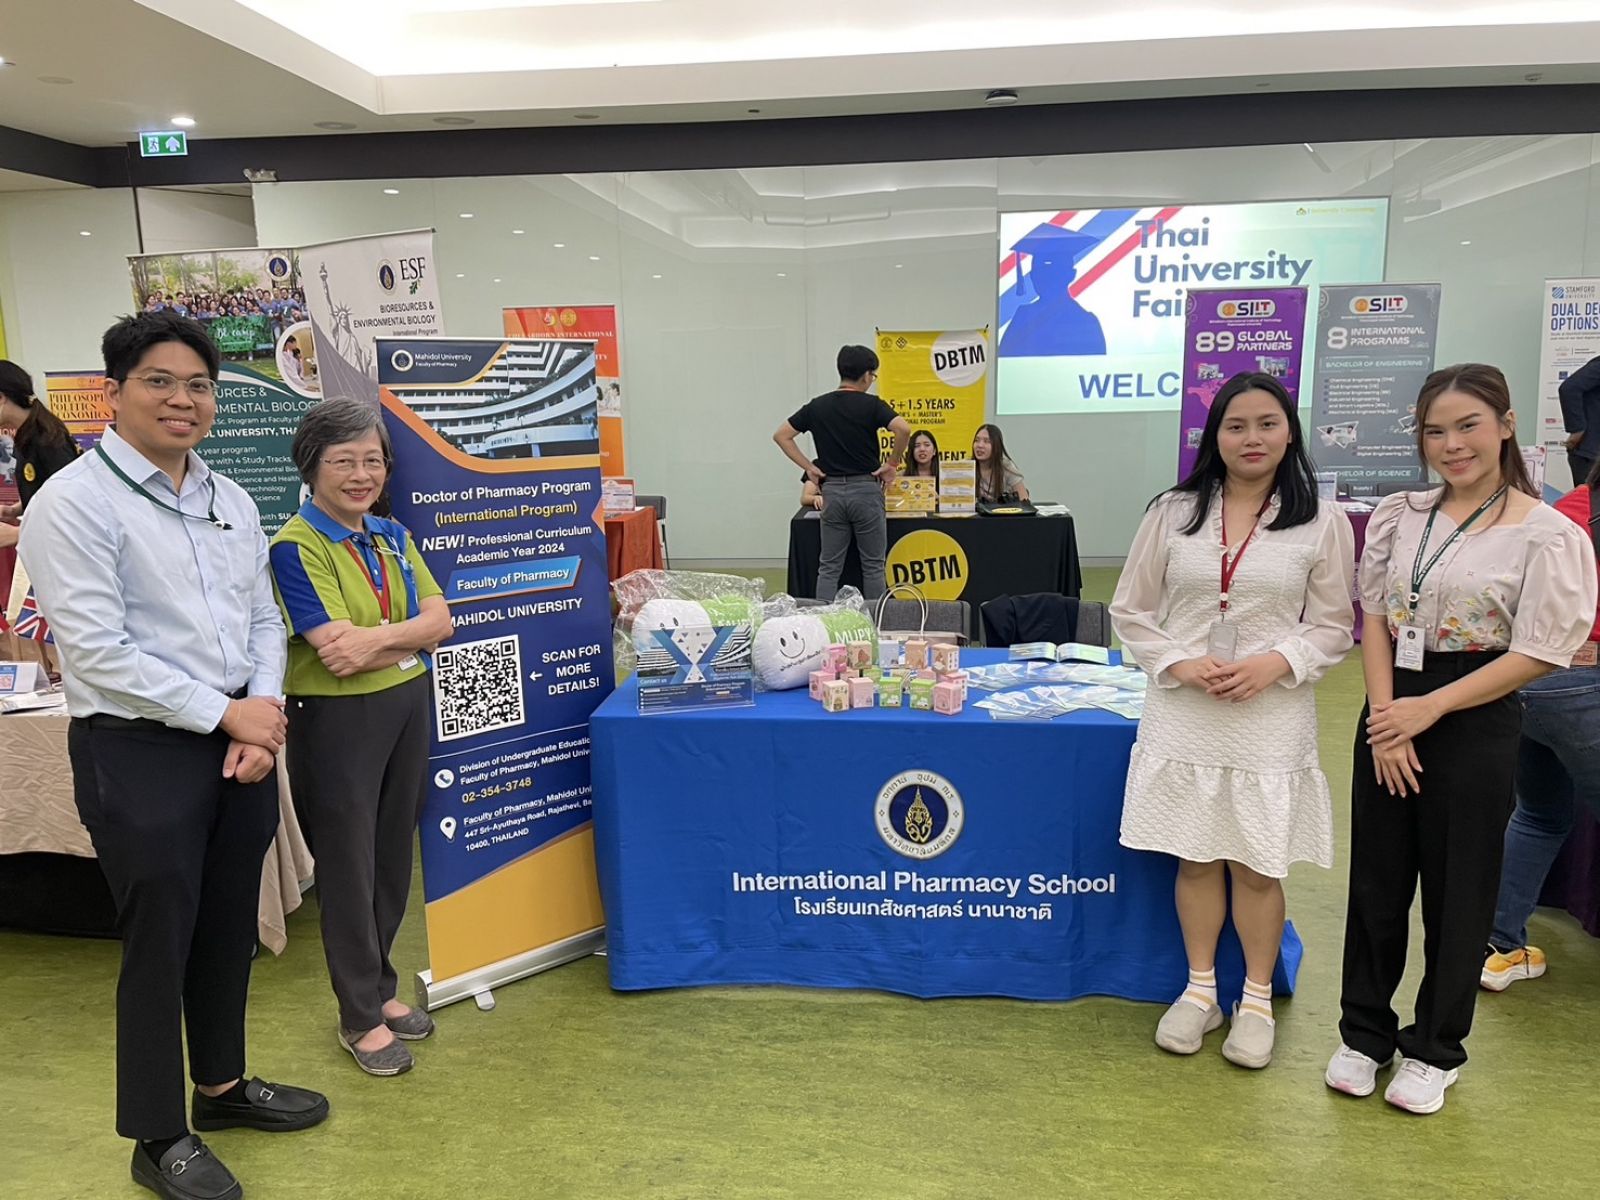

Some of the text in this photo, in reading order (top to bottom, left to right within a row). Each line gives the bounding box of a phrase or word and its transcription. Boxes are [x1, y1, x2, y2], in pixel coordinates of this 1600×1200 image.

[1135, 217, 1210, 249] Thai
[399, 257, 426, 280] ESF
[1134, 249, 1313, 286] University
[380, 301, 434, 313] BIORESOURCES &
[1132, 290, 1182, 318] Fai
[1236, 301, 1270, 316] SIIT
[1369, 297, 1404, 312] SIIT
[1551, 302, 1600, 317] DUAL DE
[353, 315, 436, 328] ENVIRONMENTAL BIOLOGY
[1550, 317, 1599, 331] OPTIONS
[1195, 330, 1293, 352] 89 GLOBAL
[1237, 342, 1293, 352] PARTNERS
[1327, 326, 1425, 349] 8 INTERNATIONAL
[1350, 336, 1410, 346] PROGRAMS
[441, 353, 472, 362] University
[934, 344, 985, 371] DBTM
[1326, 361, 1362, 369] BACHELOR
[1376, 360, 1423, 368] ENGINEERING
[216, 387, 267, 398] URCES &
[1079, 371, 1180, 399] WELC
[215, 401, 319, 414] MENTAL BIOLOG
[908, 399, 922, 410] 1.5
[925, 399, 955, 410] YEARS
[57, 411, 110, 420] CONOMICS
[228, 417, 259, 425] Program
[268, 416, 292, 424] Faculty
[217, 427, 279, 438] UNIVERSITY,
[881, 436, 895, 449] DE
[203, 448, 220, 456] year
[222, 446, 257, 456] program
[242, 456, 266, 465] Study
[267, 455, 291, 463] Tracks
[234, 466, 284, 474] Environmental
[412, 480, 592, 505] Doctor of Pharmacy Program
[435, 500, 577, 527] (International Program)
[422, 525, 592, 552] NEW! Professional Curriculum
[456, 542, 565, 565] Academic Year 2024
[456, 567, 570, 592] Faculty of Pharmacy
[892, 555, 961, 587] DBTM
[507, 597, 583, 619] UNIVERSITY
[542, 644, 601, 664] SCAN FOR
[556, 662, 591, 678] MORE
[548, 676, 600, 695] DETAILS!
[460, 760, 490, 774] Division
[492, 757, 500, 766] of
[501, 744, 557, 763] Undergraduate
[461, 749, 590, 785] Faculty of Pharmacy, Mahidol Univ
[462, 777, 532, 804] 02-354-3748
[464, 812, 493, 826] Faculty
[494, 808, 502, 818] of
[504, 798, 546, 815] Pharmacy,
[547, 789, 577, 803] Mahidol
[465, 830, 478, 839] 447
[479, 816, 526, 835] Sri-Ayuthaya
[527, 811, 547, 822] Road,
[548, 803, 582, 818] Rajathevi,
[465, 827, 529, 852] 10400, THAILAND
[732, 870, 1116, 898] International Pharmacy School
[794, 896, 1052, 922] โรงเรียนเภสัชศาสตร์ นานาชาติ
